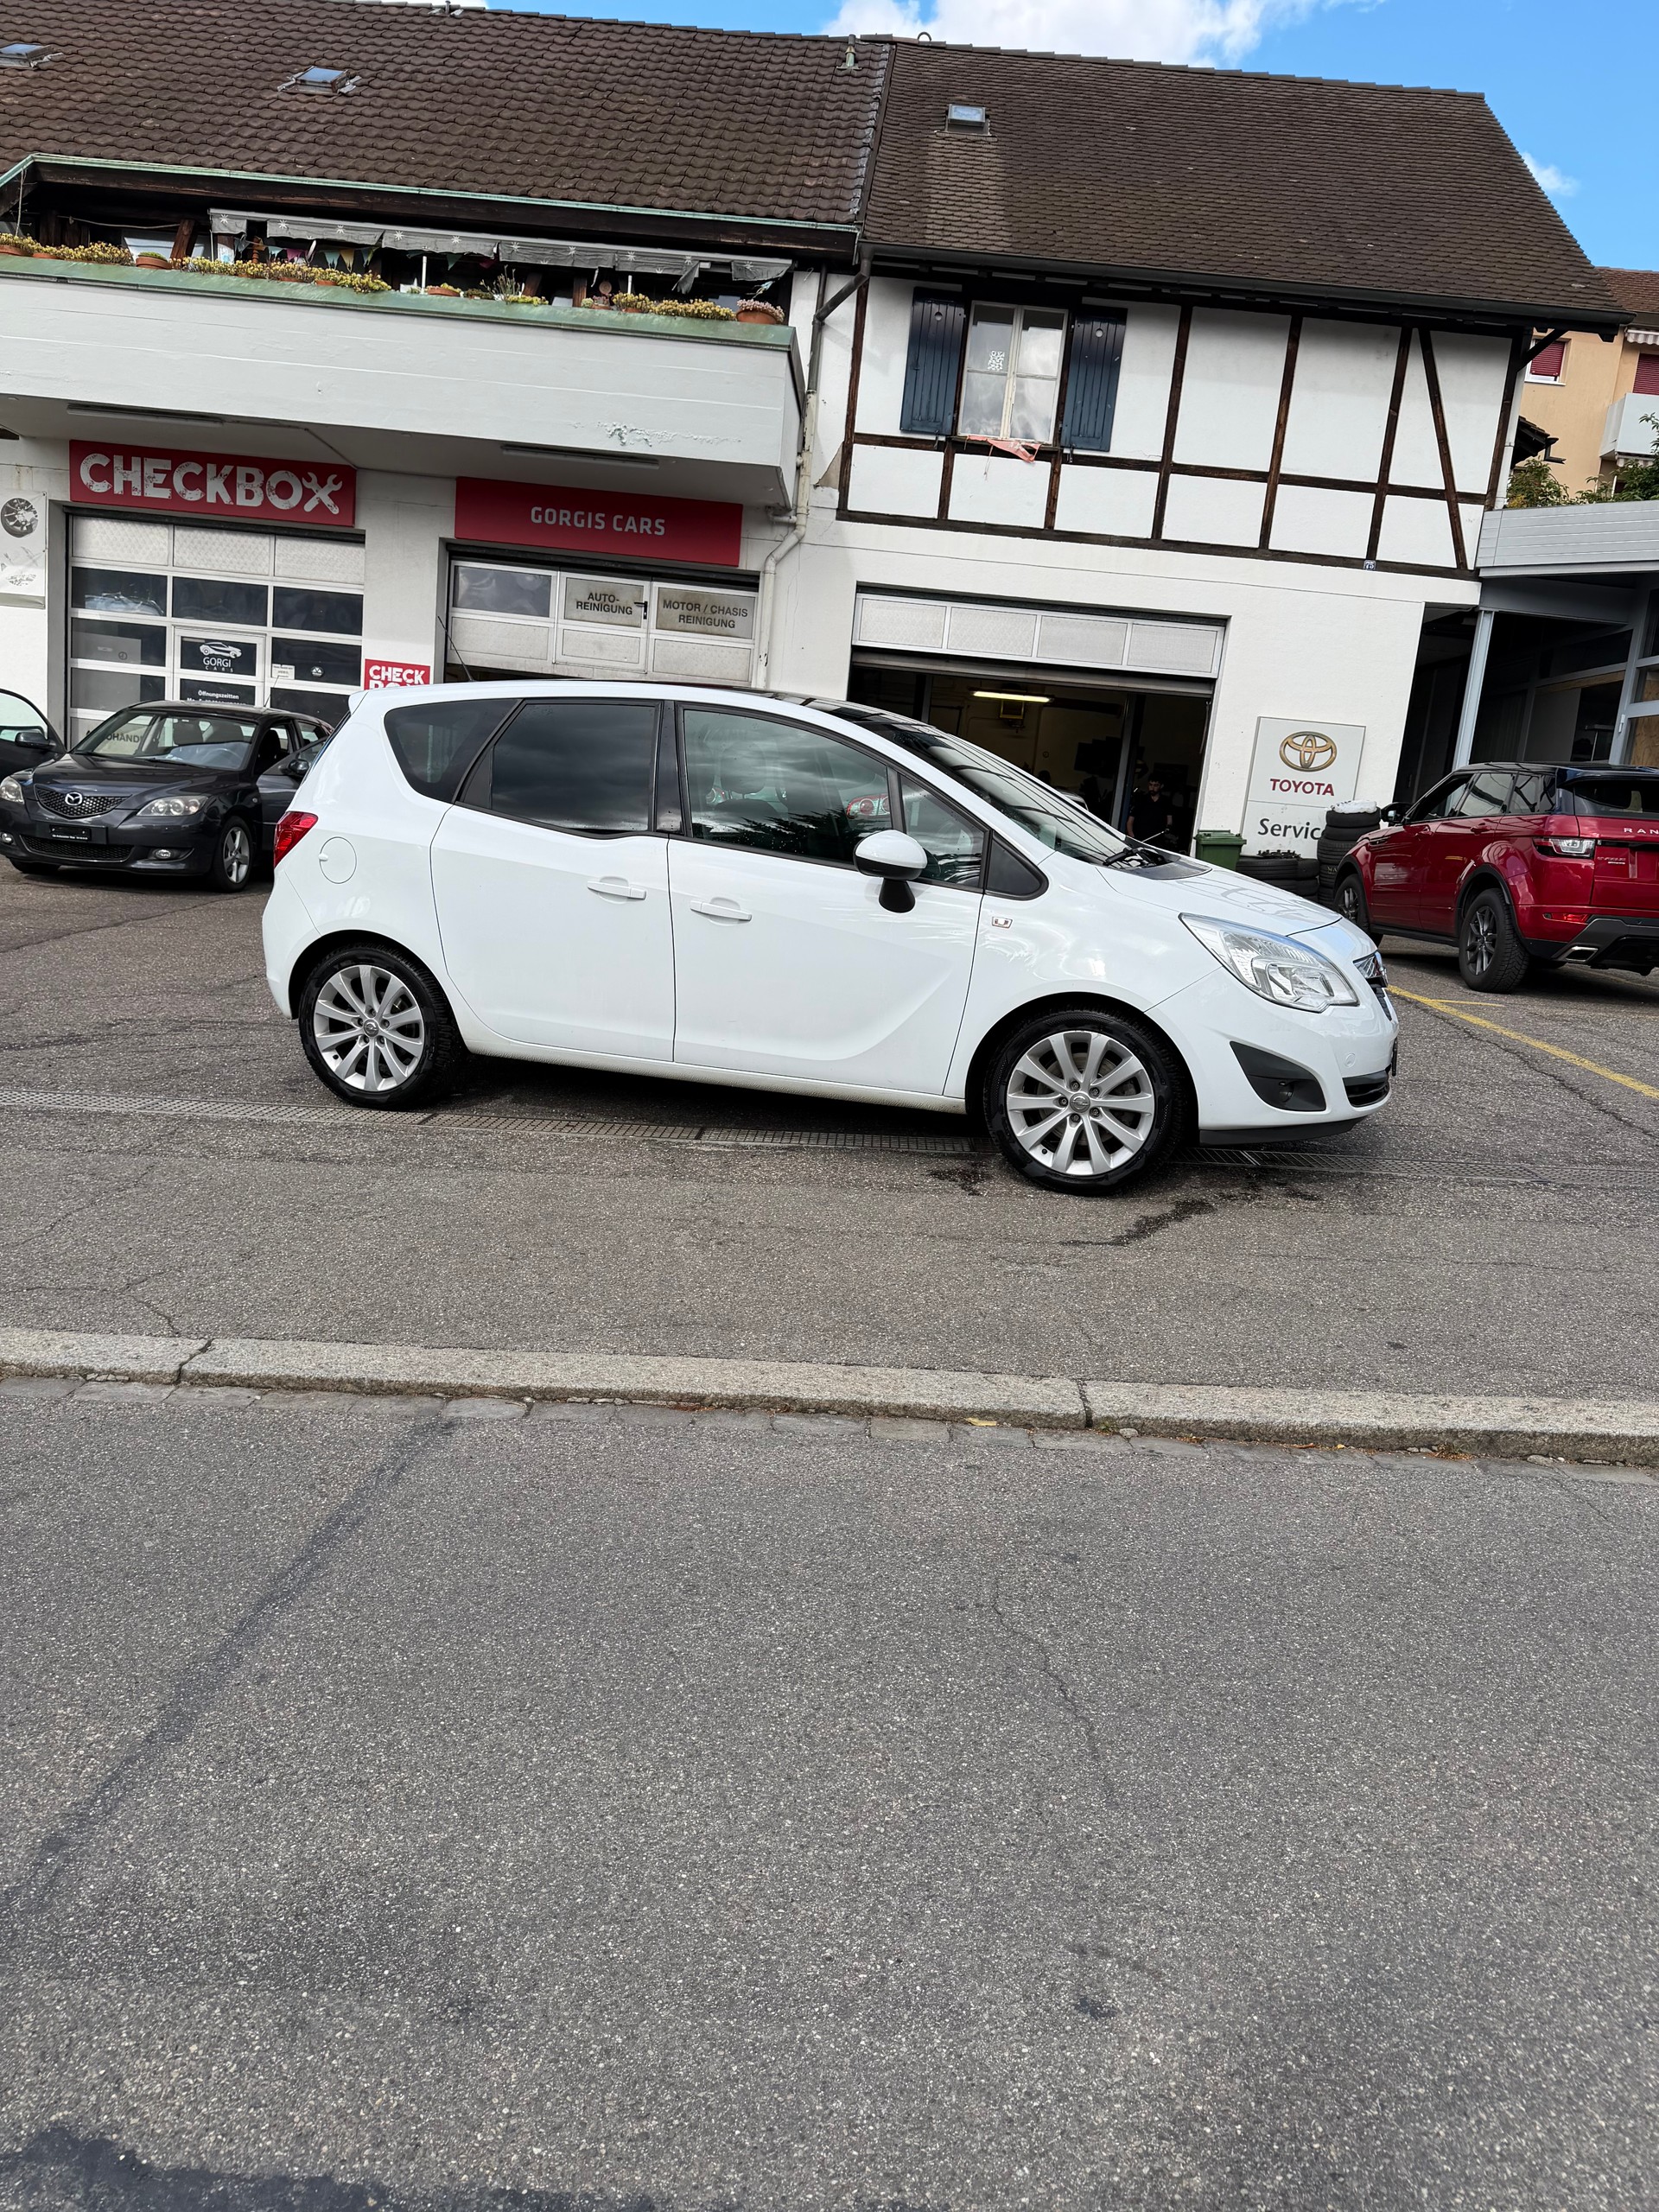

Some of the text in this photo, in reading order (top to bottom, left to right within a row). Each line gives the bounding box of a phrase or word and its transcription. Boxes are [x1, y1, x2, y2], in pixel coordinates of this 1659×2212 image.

[531, 506, 665, 536] GORGIS CARS
[588, 592, 620, 603] AUTO-
[575, 601, 632, 615] REINIGUNG
[663, 600, 701, 612] MOTOR
[710, 605, 748, 617] CHASIS
[678, 614, 735, 629] REINIGUNG
[203, 657, 232, 668] GORGI
[369, 664, 425, 684] CHECK
[1270, 779, 1334, 796] TOYOTA
[1257, 817, 1323, 841] Servic
